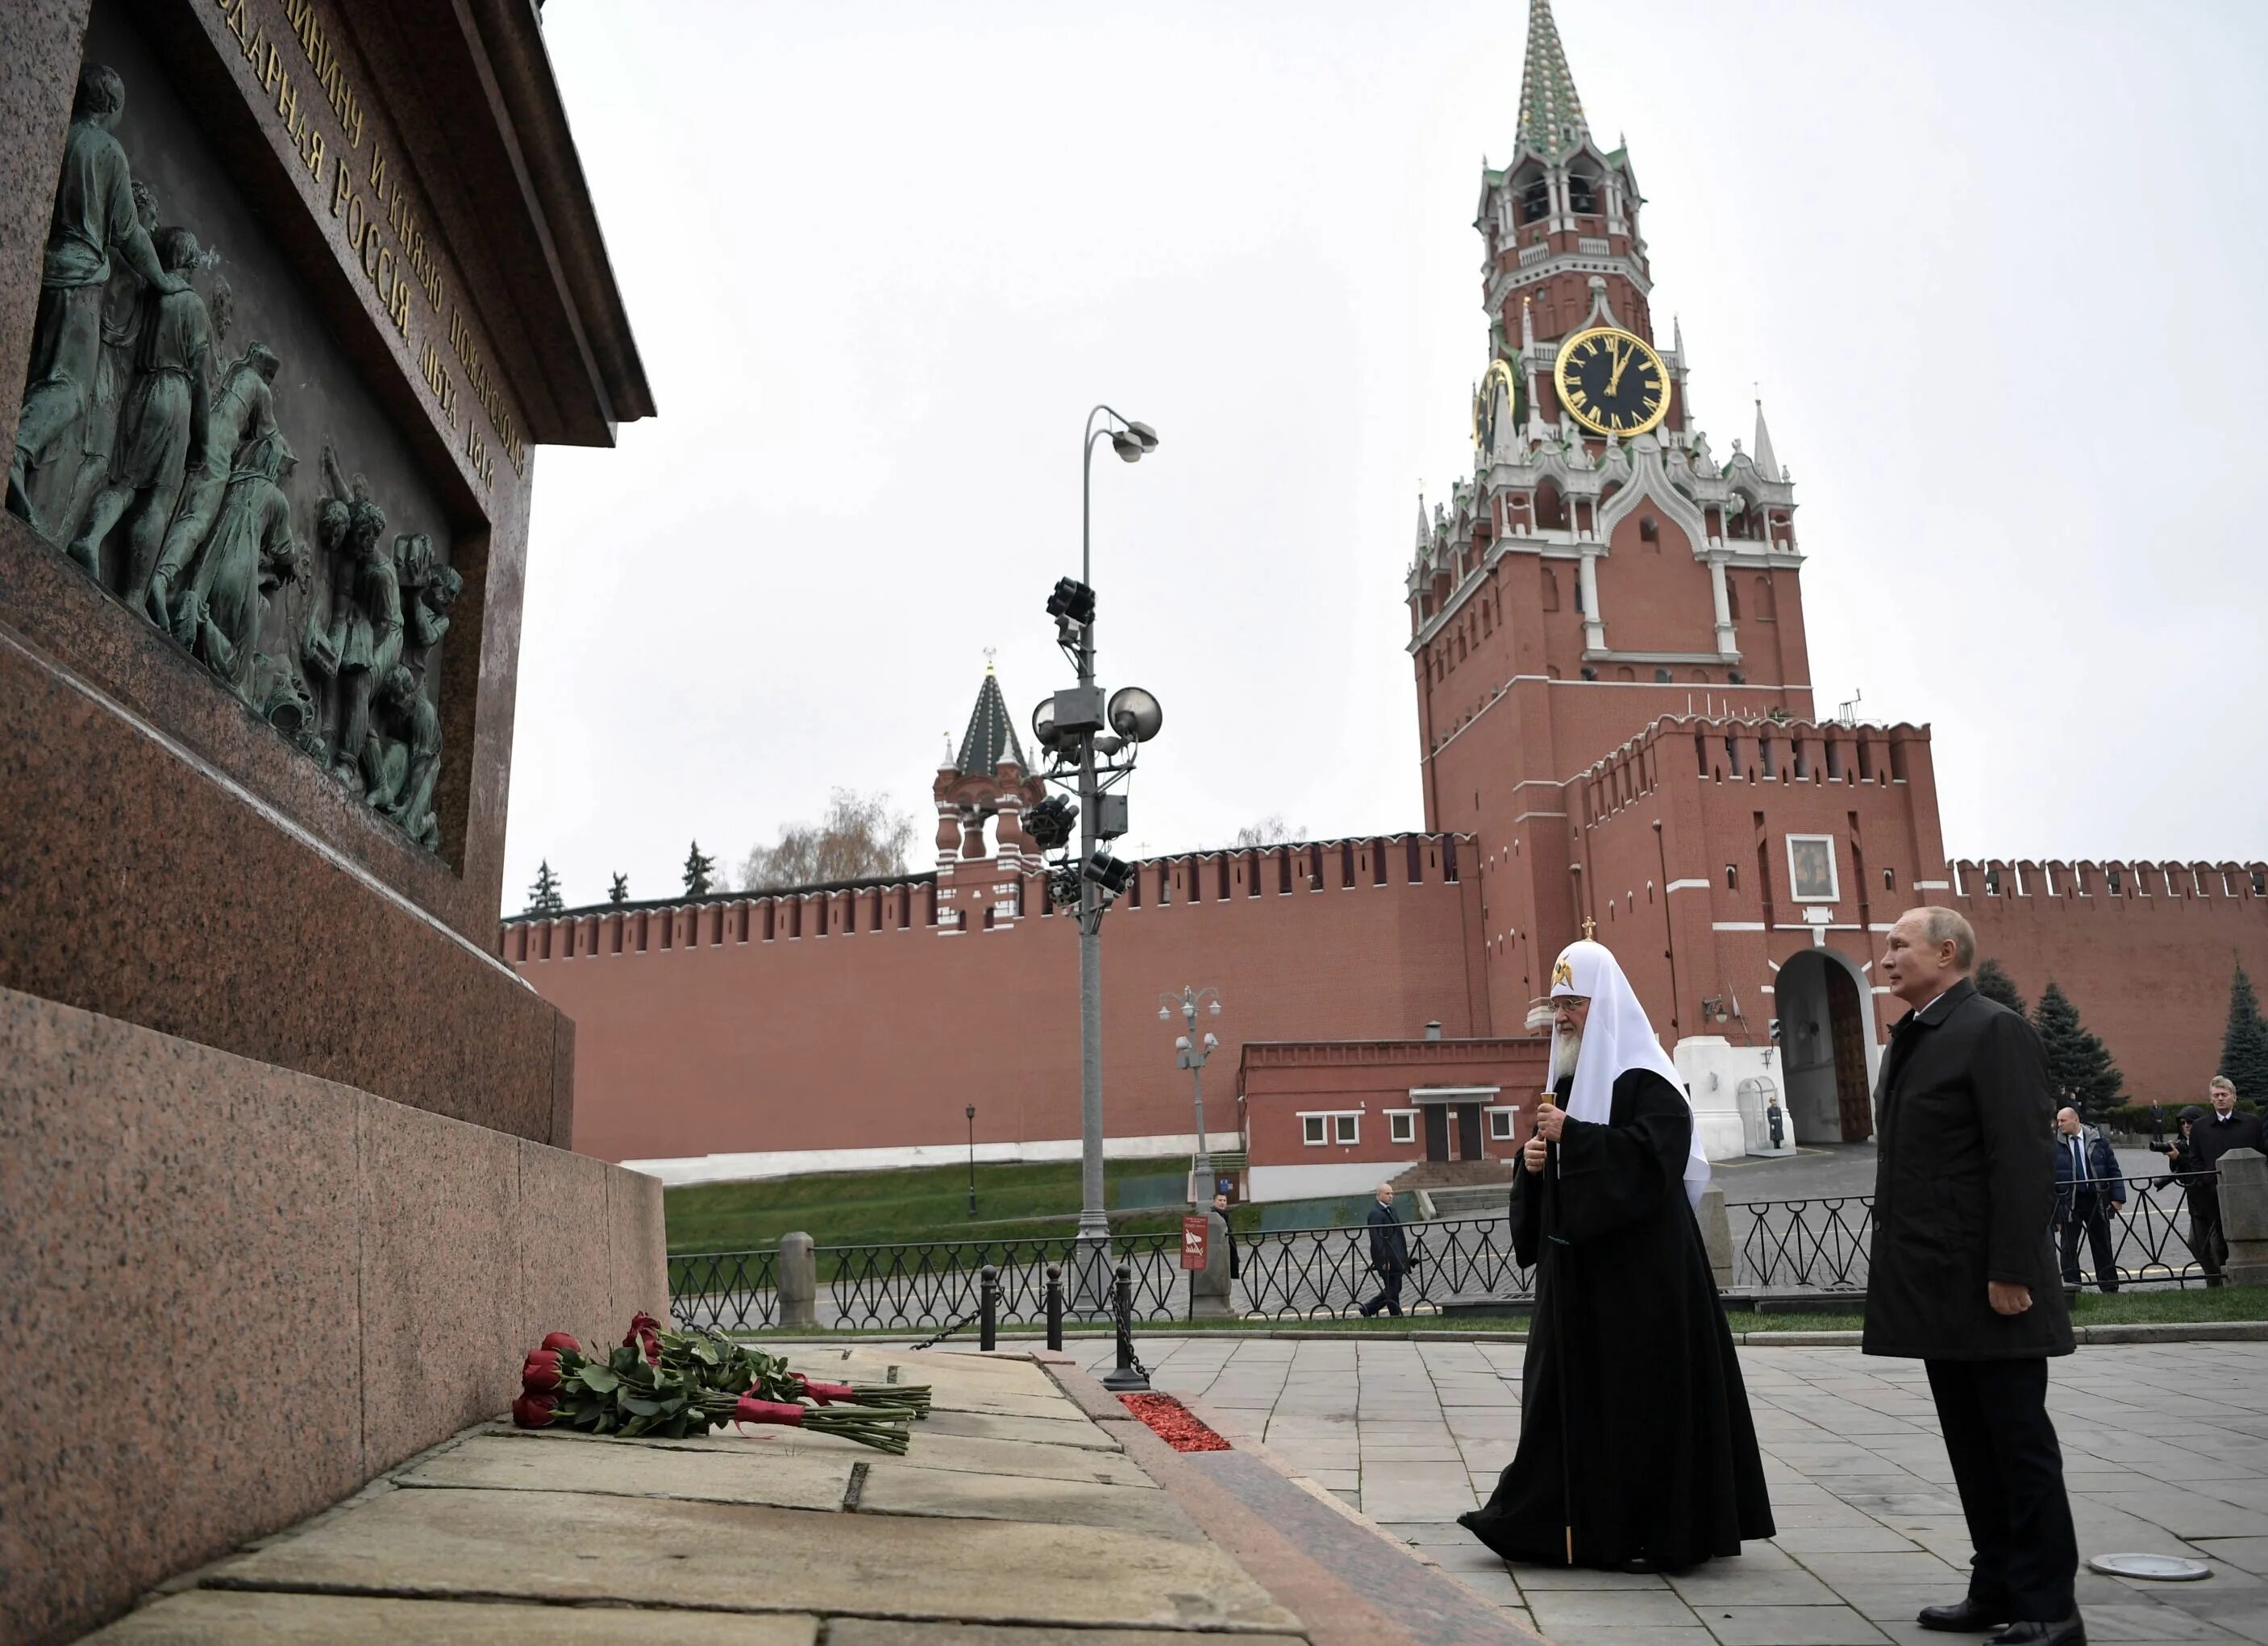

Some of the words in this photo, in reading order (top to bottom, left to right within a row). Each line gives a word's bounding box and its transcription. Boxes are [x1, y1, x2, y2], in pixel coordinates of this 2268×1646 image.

[218, 0, 325, 183] ДАРНАЯ
[468, 422, 494, 493] 1818
[370, 143, 386, 199] И
[389, 181, 443, 314] КНЯЗЮ
[450, 306, 524, 480] ПОЖАРСКОМУ
